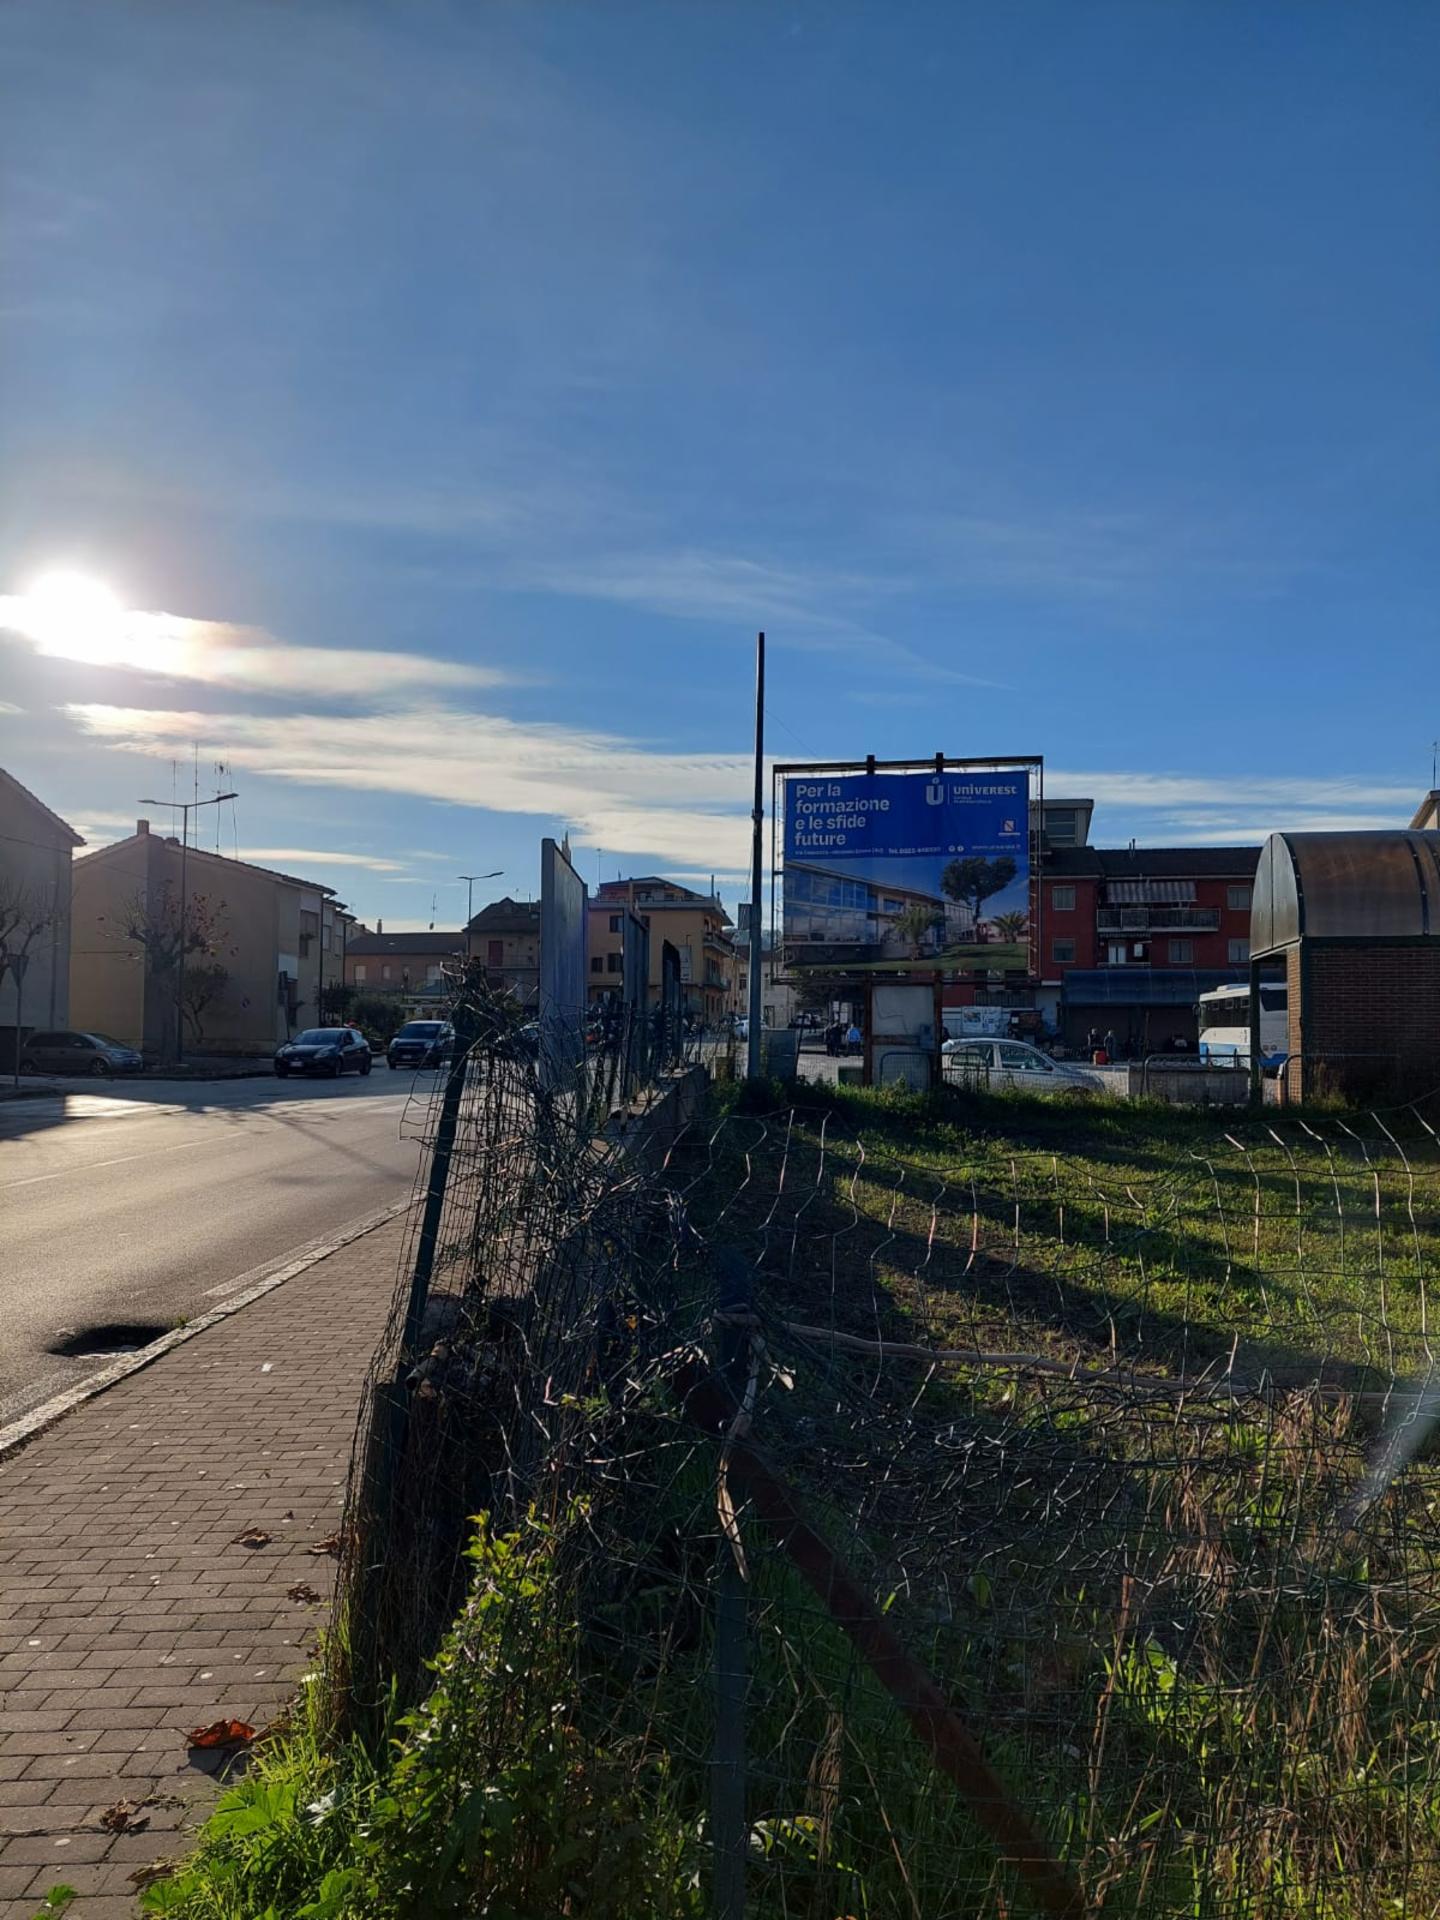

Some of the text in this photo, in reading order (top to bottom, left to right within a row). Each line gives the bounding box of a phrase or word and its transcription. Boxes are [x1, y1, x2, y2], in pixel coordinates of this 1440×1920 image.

[796, 783, 841, 798] Per la
[795, 797, 890, 814] formazione
[795, 814, 867, 830] e le sfide
[794, 832, 847, 846] future
